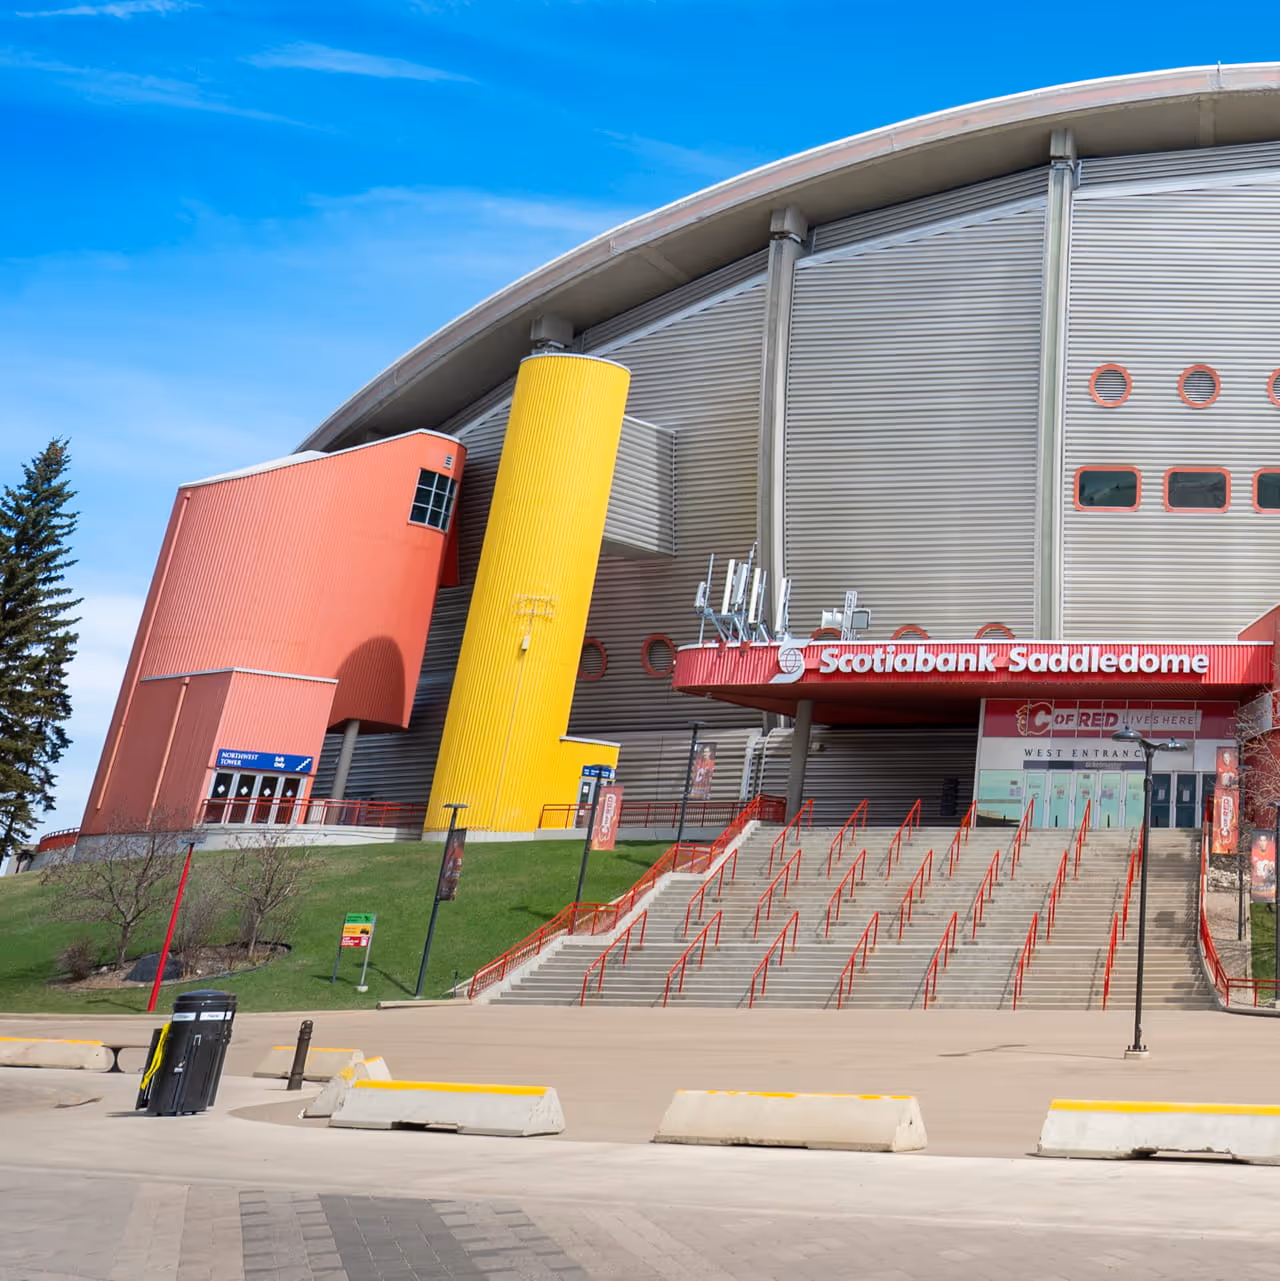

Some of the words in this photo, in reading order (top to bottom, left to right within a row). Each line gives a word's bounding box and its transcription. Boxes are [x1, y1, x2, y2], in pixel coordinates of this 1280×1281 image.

[820, 645, 997, 673] Scotiabank
[1009, 646, 1209, 674] Saddledome
[1054, 714, 1075, 725] OF
[1079, 712, 1119, 727] RED
[1122, 715, 1159, 725] LIVES
[1162, 715, 1194, 725] HERE
[1024, 749, 1063, 758] WEST
[1072, 749, 1141, 758] ENTRANC
